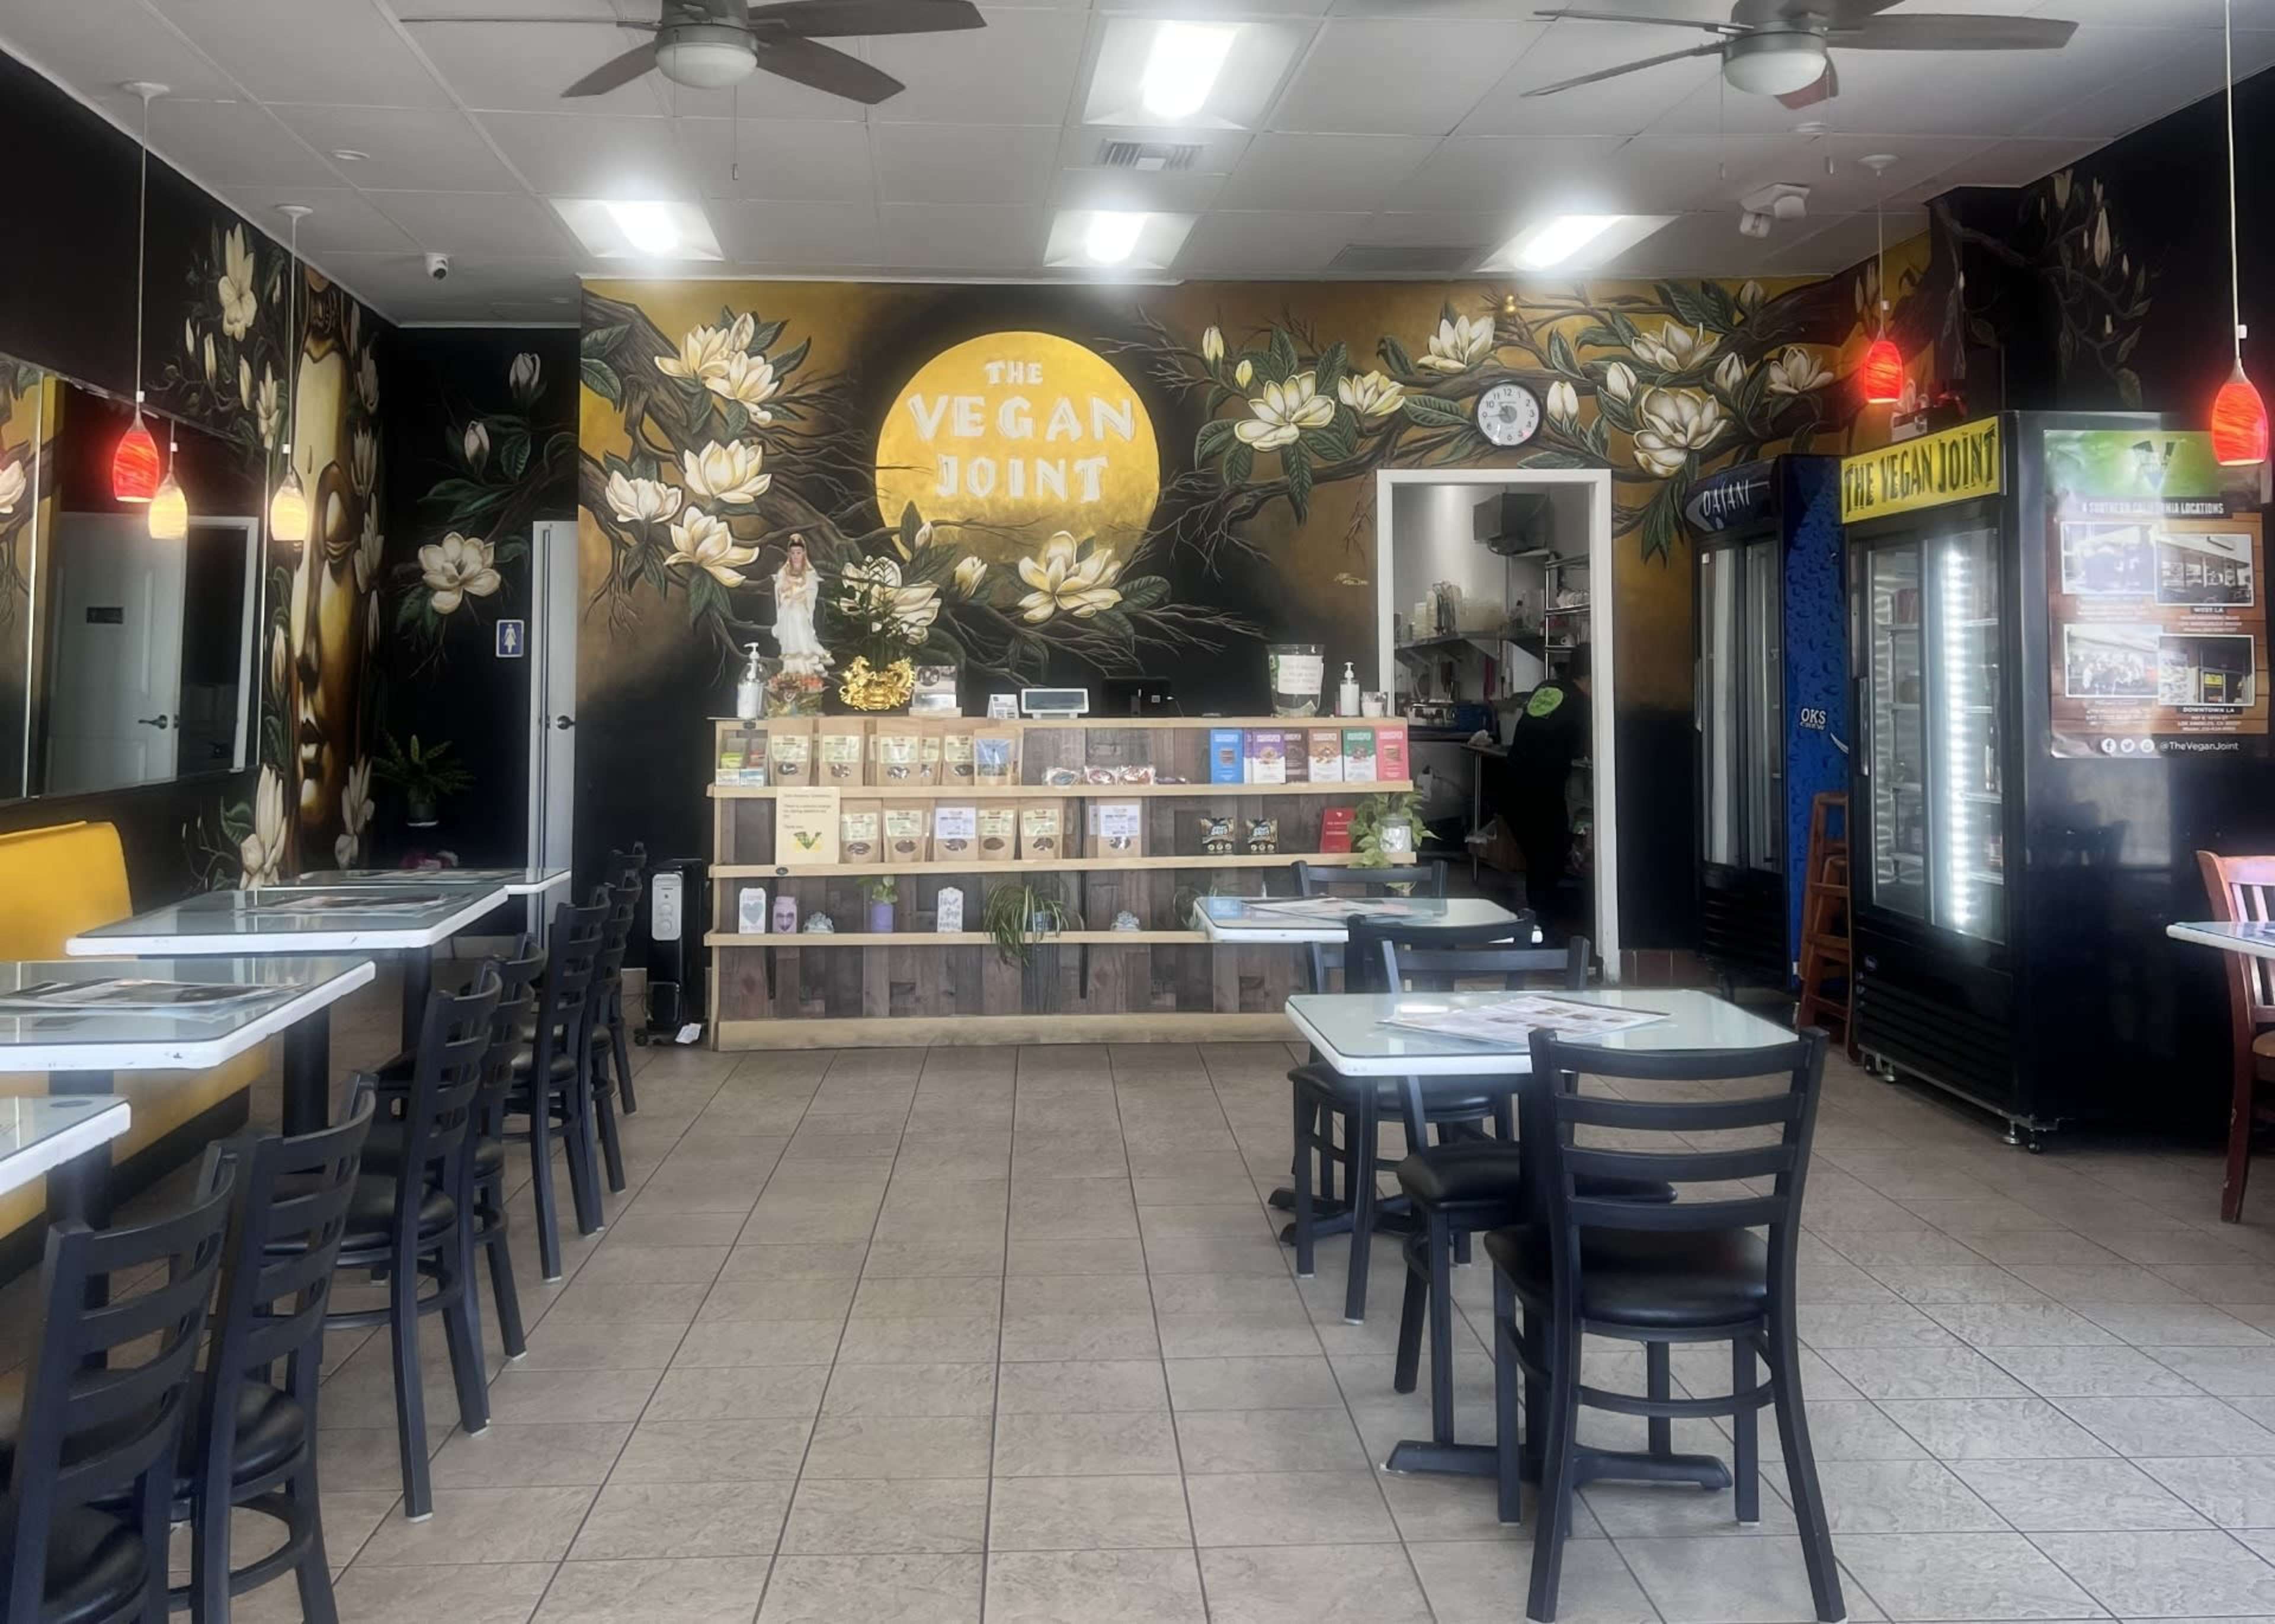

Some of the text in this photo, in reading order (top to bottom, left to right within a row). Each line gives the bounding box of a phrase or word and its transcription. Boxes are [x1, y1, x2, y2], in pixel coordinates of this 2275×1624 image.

[984, 359, 1043, 386] THE
[1503, 388, 1512, 396] 12
[907, 394, 1136, 442] VEGAN
[935, 454, 1109, 503] JOINT
[1844, 423, 1997, 516] THE VEGAN JOINT
[1702, 478, 1750, 519] DASANI
[2181, 502, 2224, 514] LOCATIONS
[1800, 708, 1827, 724] OKS
[2159, 741, 2239, 752] @TheVeganJoint
